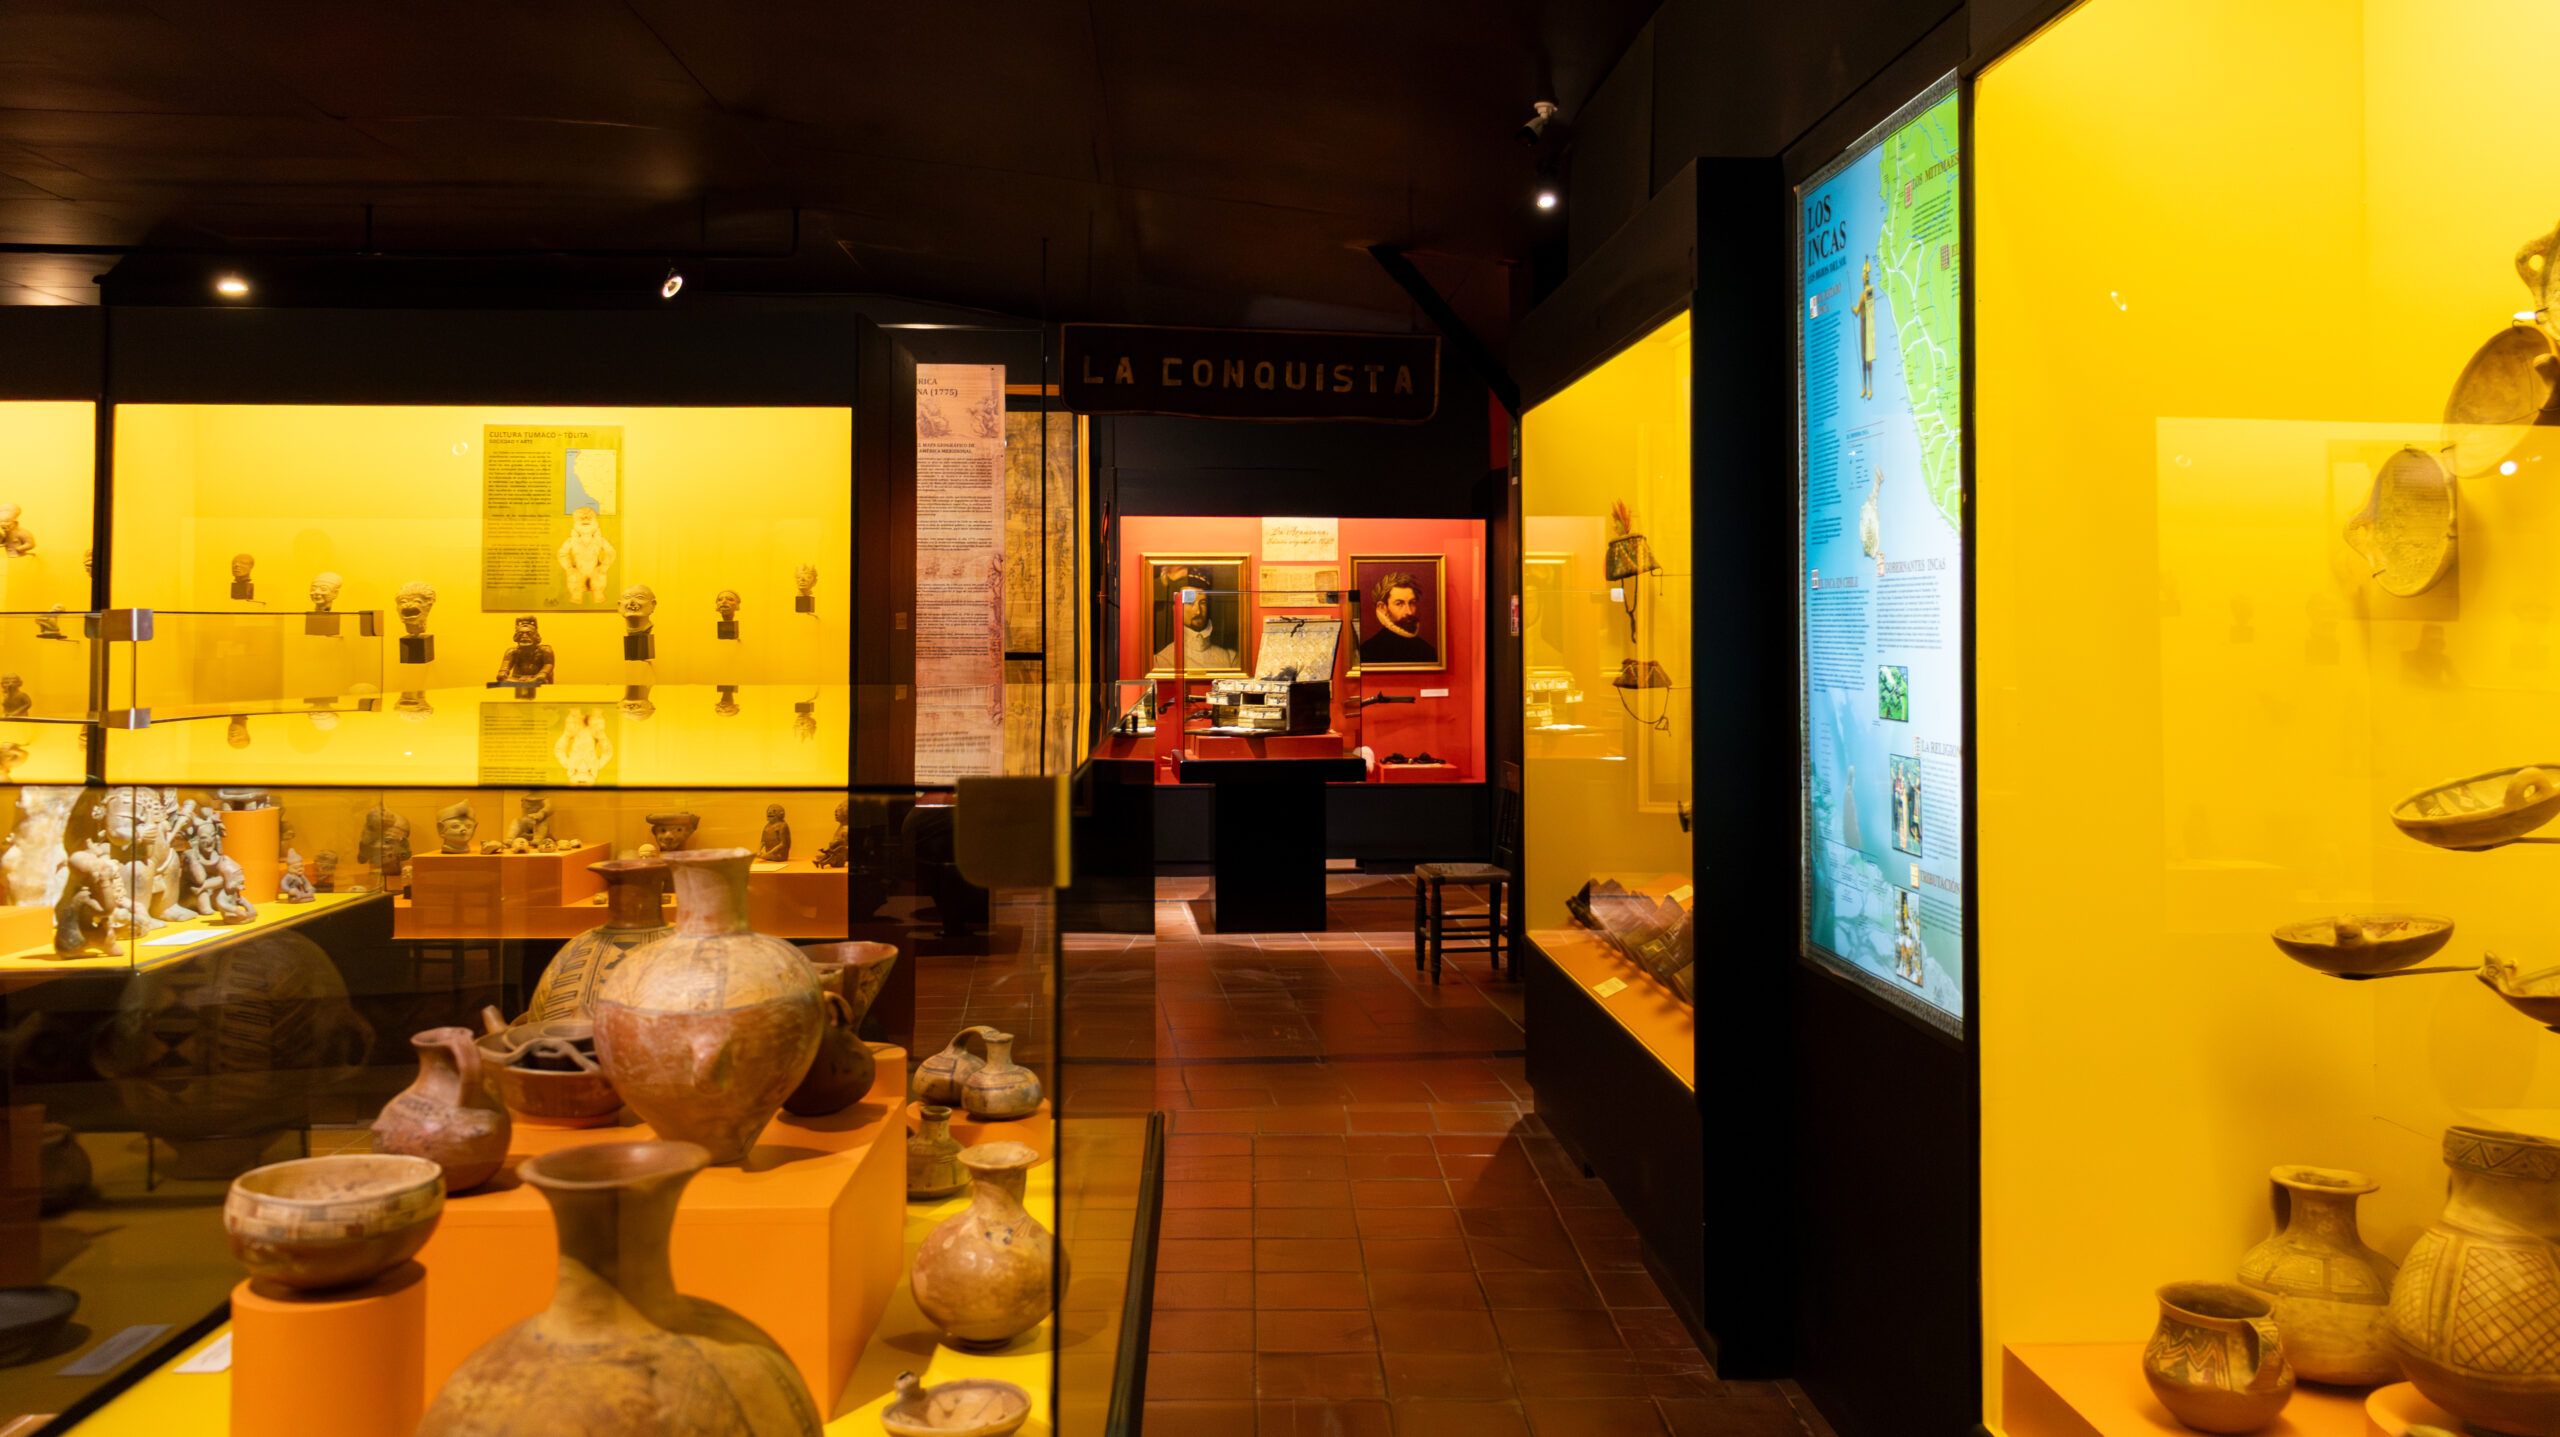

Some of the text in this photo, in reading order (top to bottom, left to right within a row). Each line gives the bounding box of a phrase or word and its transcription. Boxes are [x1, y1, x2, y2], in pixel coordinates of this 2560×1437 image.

[1808, 195, 1831, 235] LOS
[1808, 220, 1847, 267] INCAS
[1083, 355, 1415, 395] LA CONQUISTA
[930, 388, 958, 397] (1775)
[524, 431, 556, 439] TUMACO
[564, 431, 588, 439] TOLITA
[1927, 558, 1946, 571] INCAS
